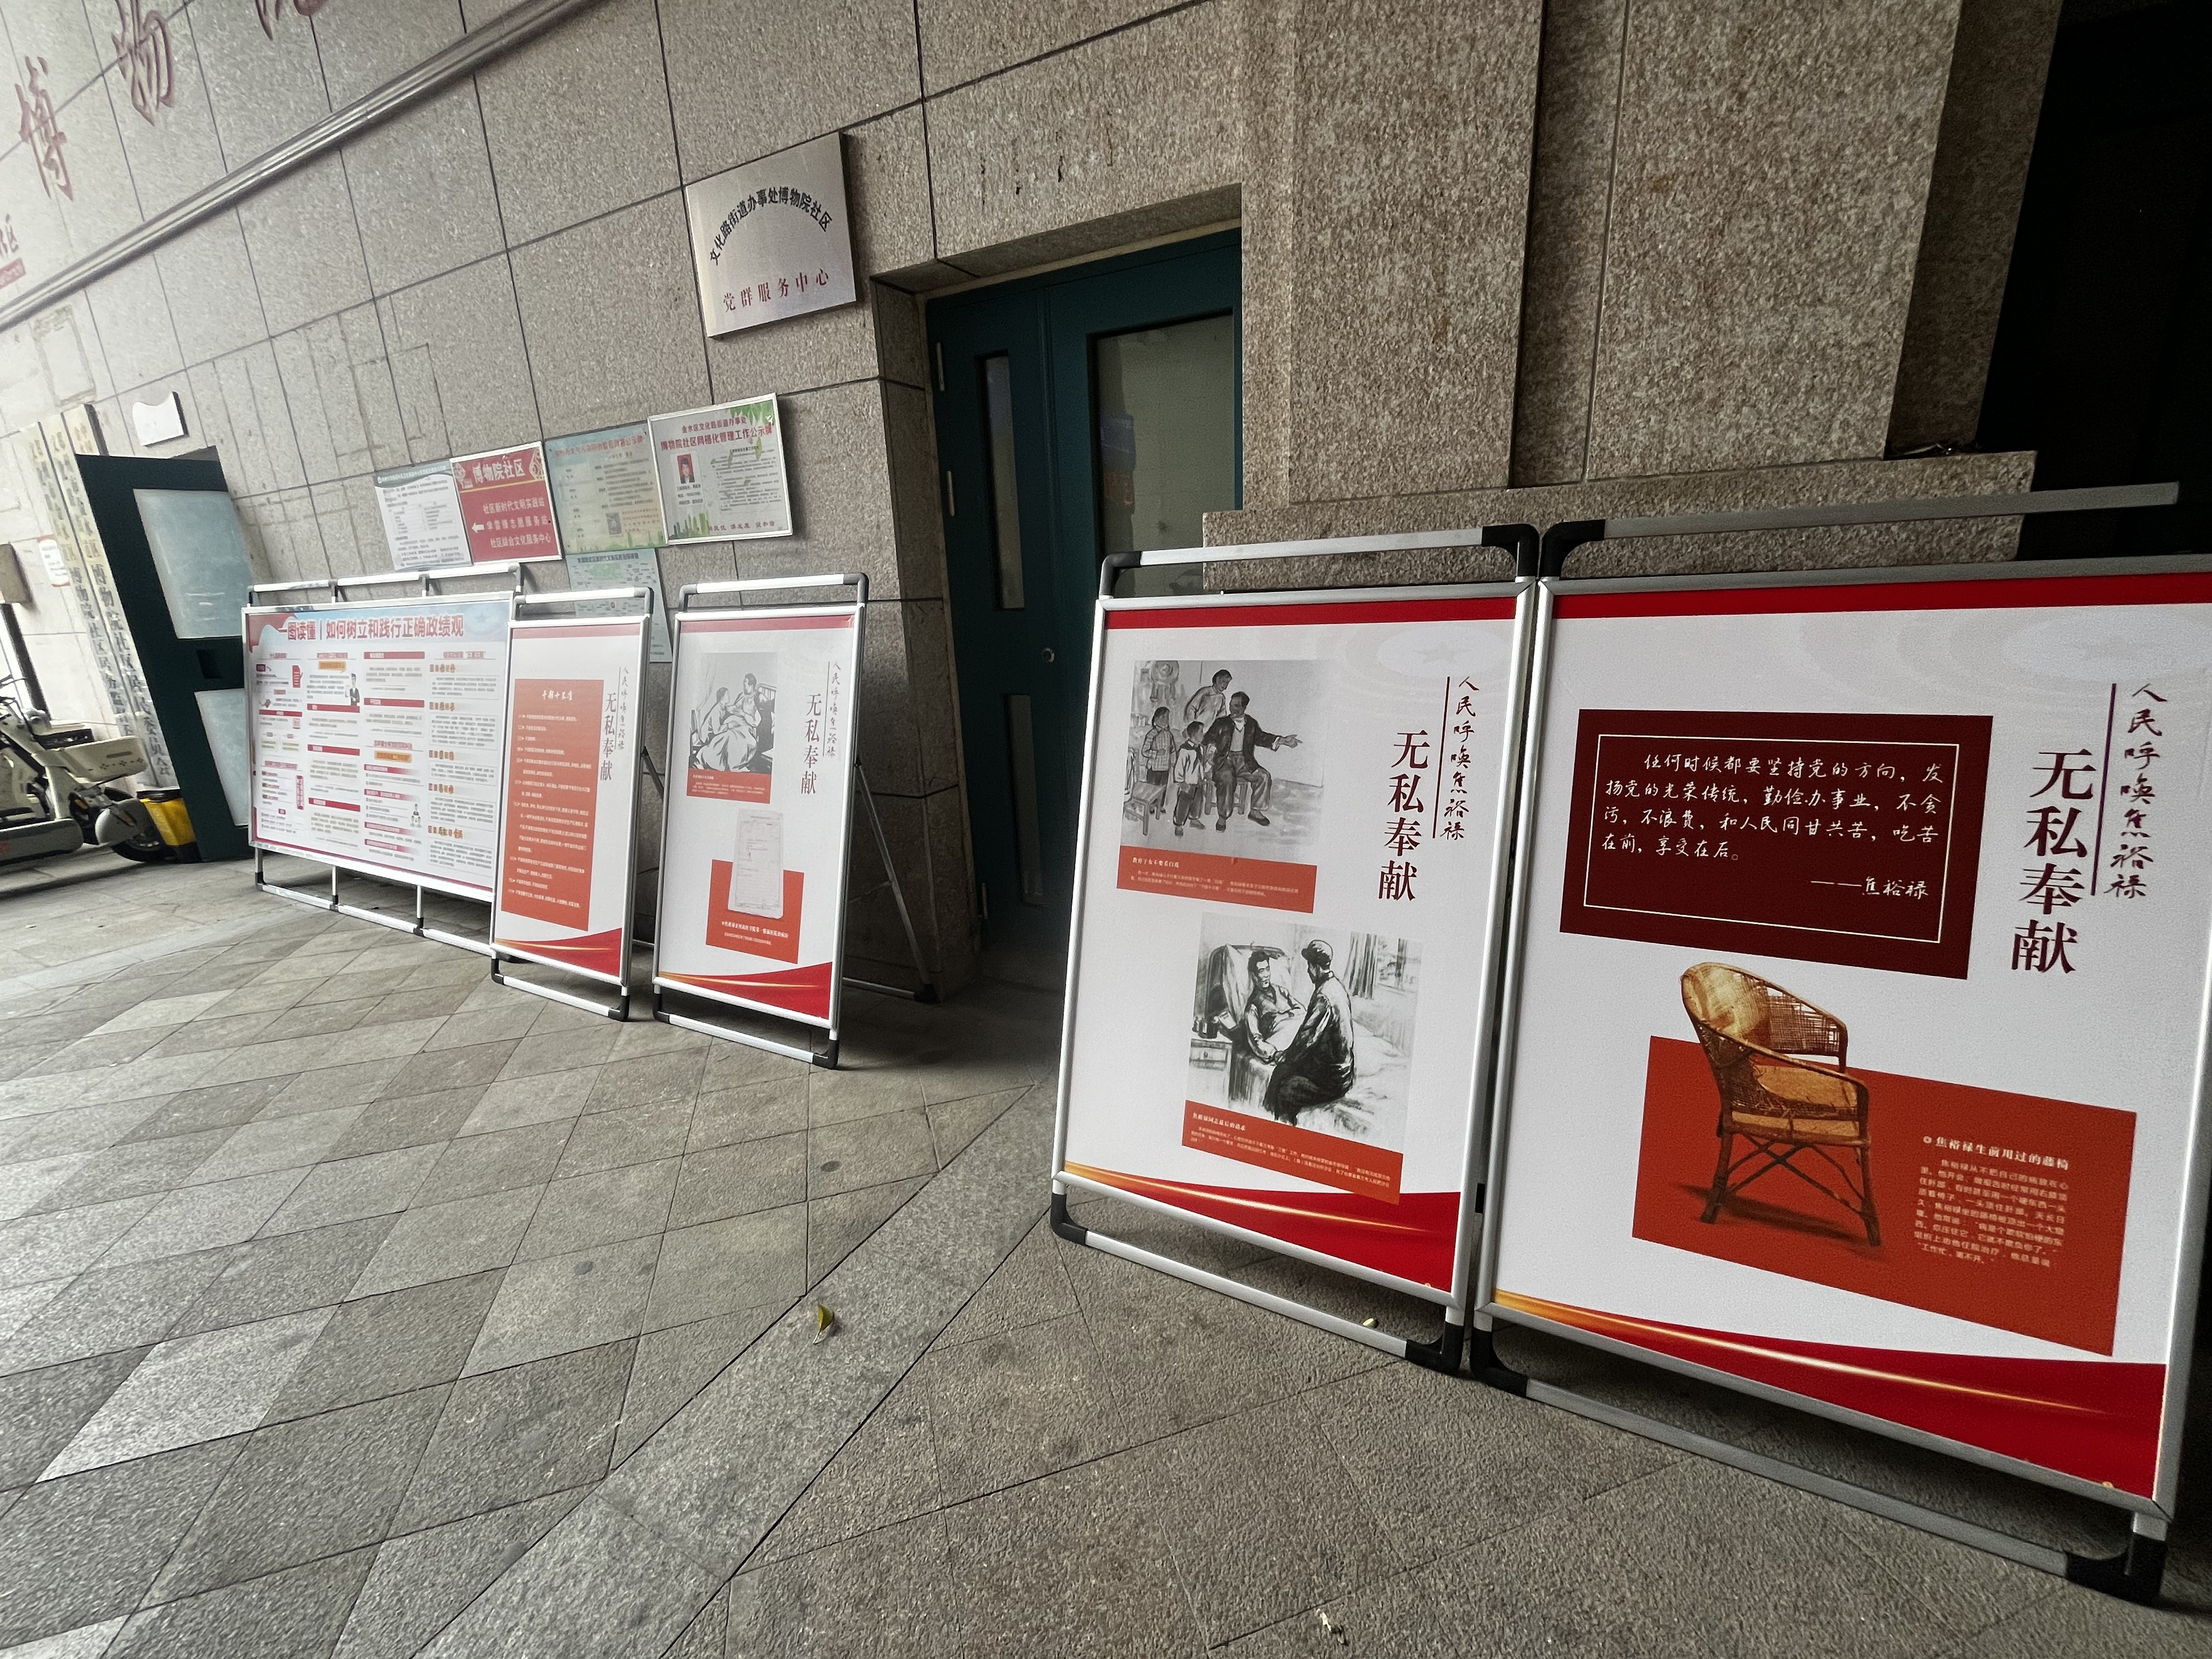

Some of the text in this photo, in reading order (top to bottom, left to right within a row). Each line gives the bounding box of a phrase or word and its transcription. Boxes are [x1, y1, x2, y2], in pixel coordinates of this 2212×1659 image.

[710, 187, 832, 266] 文化路街道办事处博物院社区
[723, 269, 829, 312] 党群服务中心
[472, 459, 526, 483] 博物院社区
[483, 497, 545, 515] 社区新时代文明实践站
[490, 533, 552, 548] 社区综合文化服务中心
[600, 692, 617, 781] 无私奉献
[800, 693, 822, 795] 无私奉献
[1440, 675, 1480, 841] 人民呼唤焦裕禄
[1378, 729, 1431, 902] 无私奉献
[2103, 684, 2168, 899] 人民呼唤焦裕禄
[2011, 748, 2097, 974] 无私奉献
